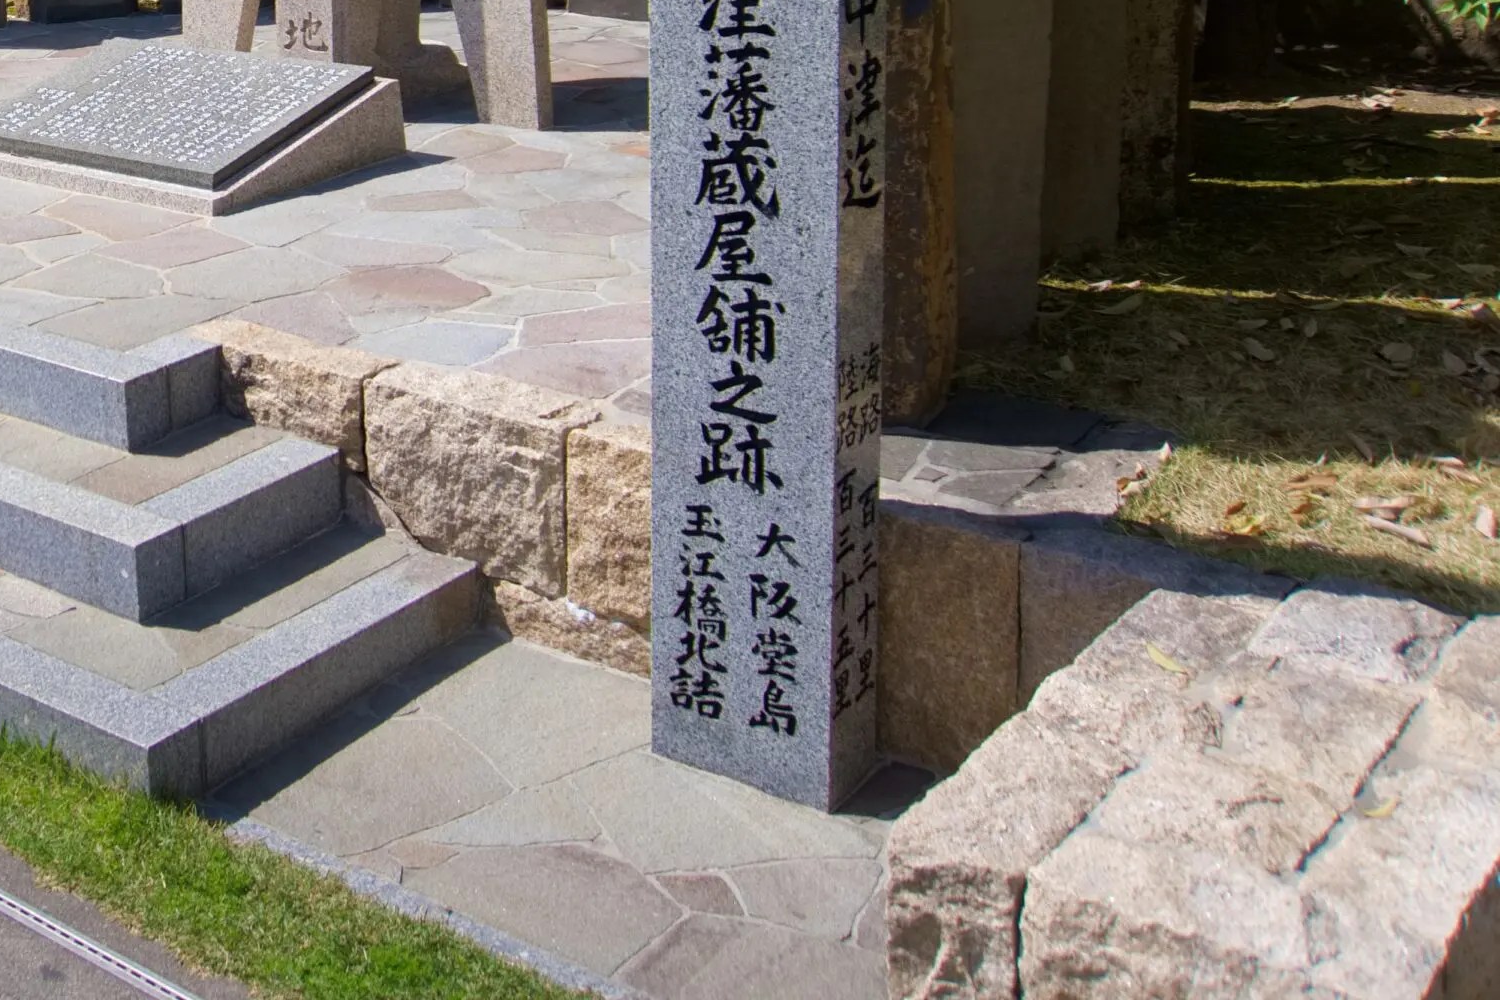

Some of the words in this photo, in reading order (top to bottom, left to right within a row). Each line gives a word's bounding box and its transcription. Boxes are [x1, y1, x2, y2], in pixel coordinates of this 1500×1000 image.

[669, 504, 728, 719] 玉江橋北詰
[750, 522, 802, 737] 大阪堂島
